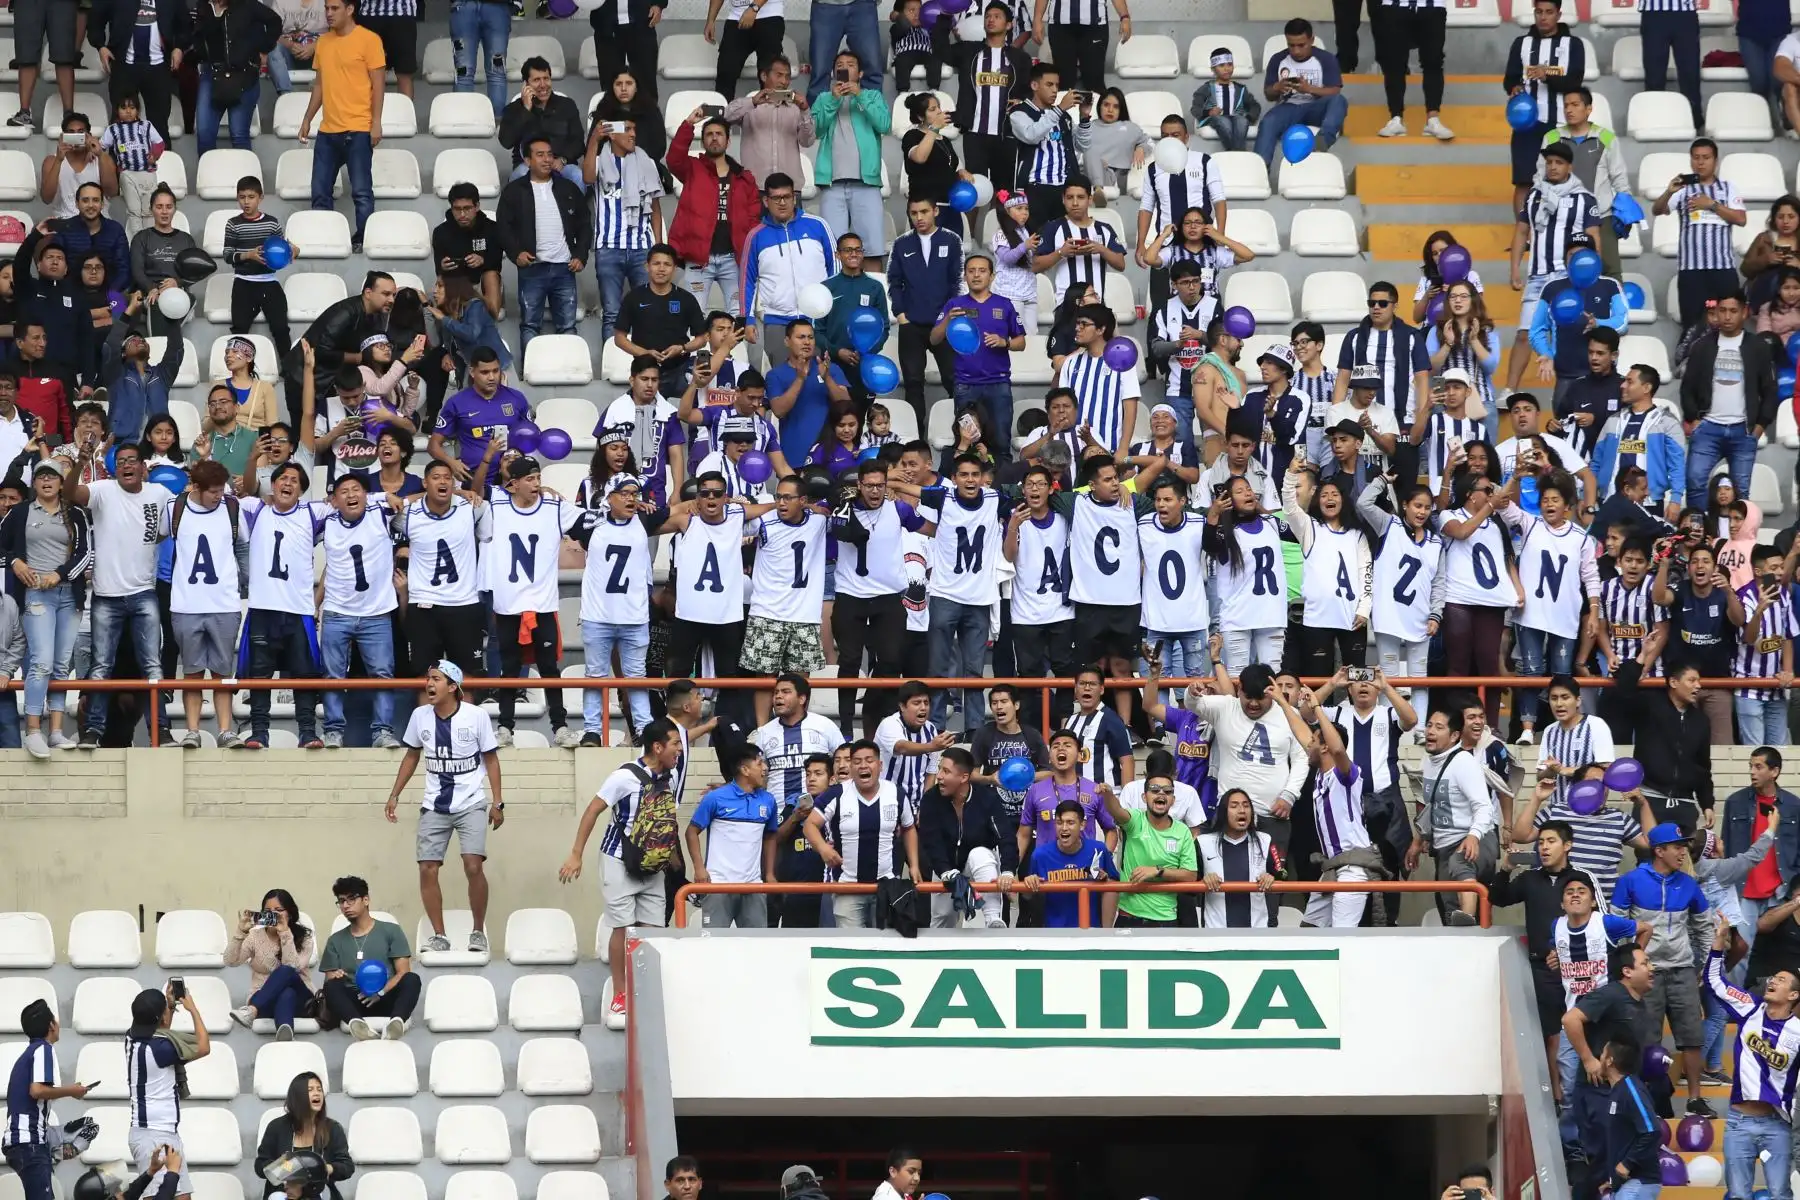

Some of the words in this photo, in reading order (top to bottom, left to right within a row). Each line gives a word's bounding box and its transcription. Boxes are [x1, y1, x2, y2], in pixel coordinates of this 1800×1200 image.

[187, 533, 219, 585] A
[267, 530, 290, 582] L
[349, 544, 370, 592] I
[430, 538, 459, 587] A
[508, 532, 539, 584] N
[604, 543, 632, 594] Z
[694, 541, 725, 593] A
[790, 540, 809, 589] L
[953, 524, 987, 575] M
[1036, 546, 1063, 595] A
[1093, 525, 1121, 576] C
[1158, 549, 1186, 601] O
[1251, 545, 1280, 596] R
[1471, 542, 1500, 590] O
[1719, 549, 1746, 568] GAP
[1335, 551, 1357, 602] A
[1392, 553, 1423, 607] Z
[1534, 549, 1569, 603] N
[1614, 626, 1641, 636] RISTAL
[437, 746, 449, 758] LA
[787, 743, 799, 755] LA
[824, 966, 1327, 1031] SALIDA
